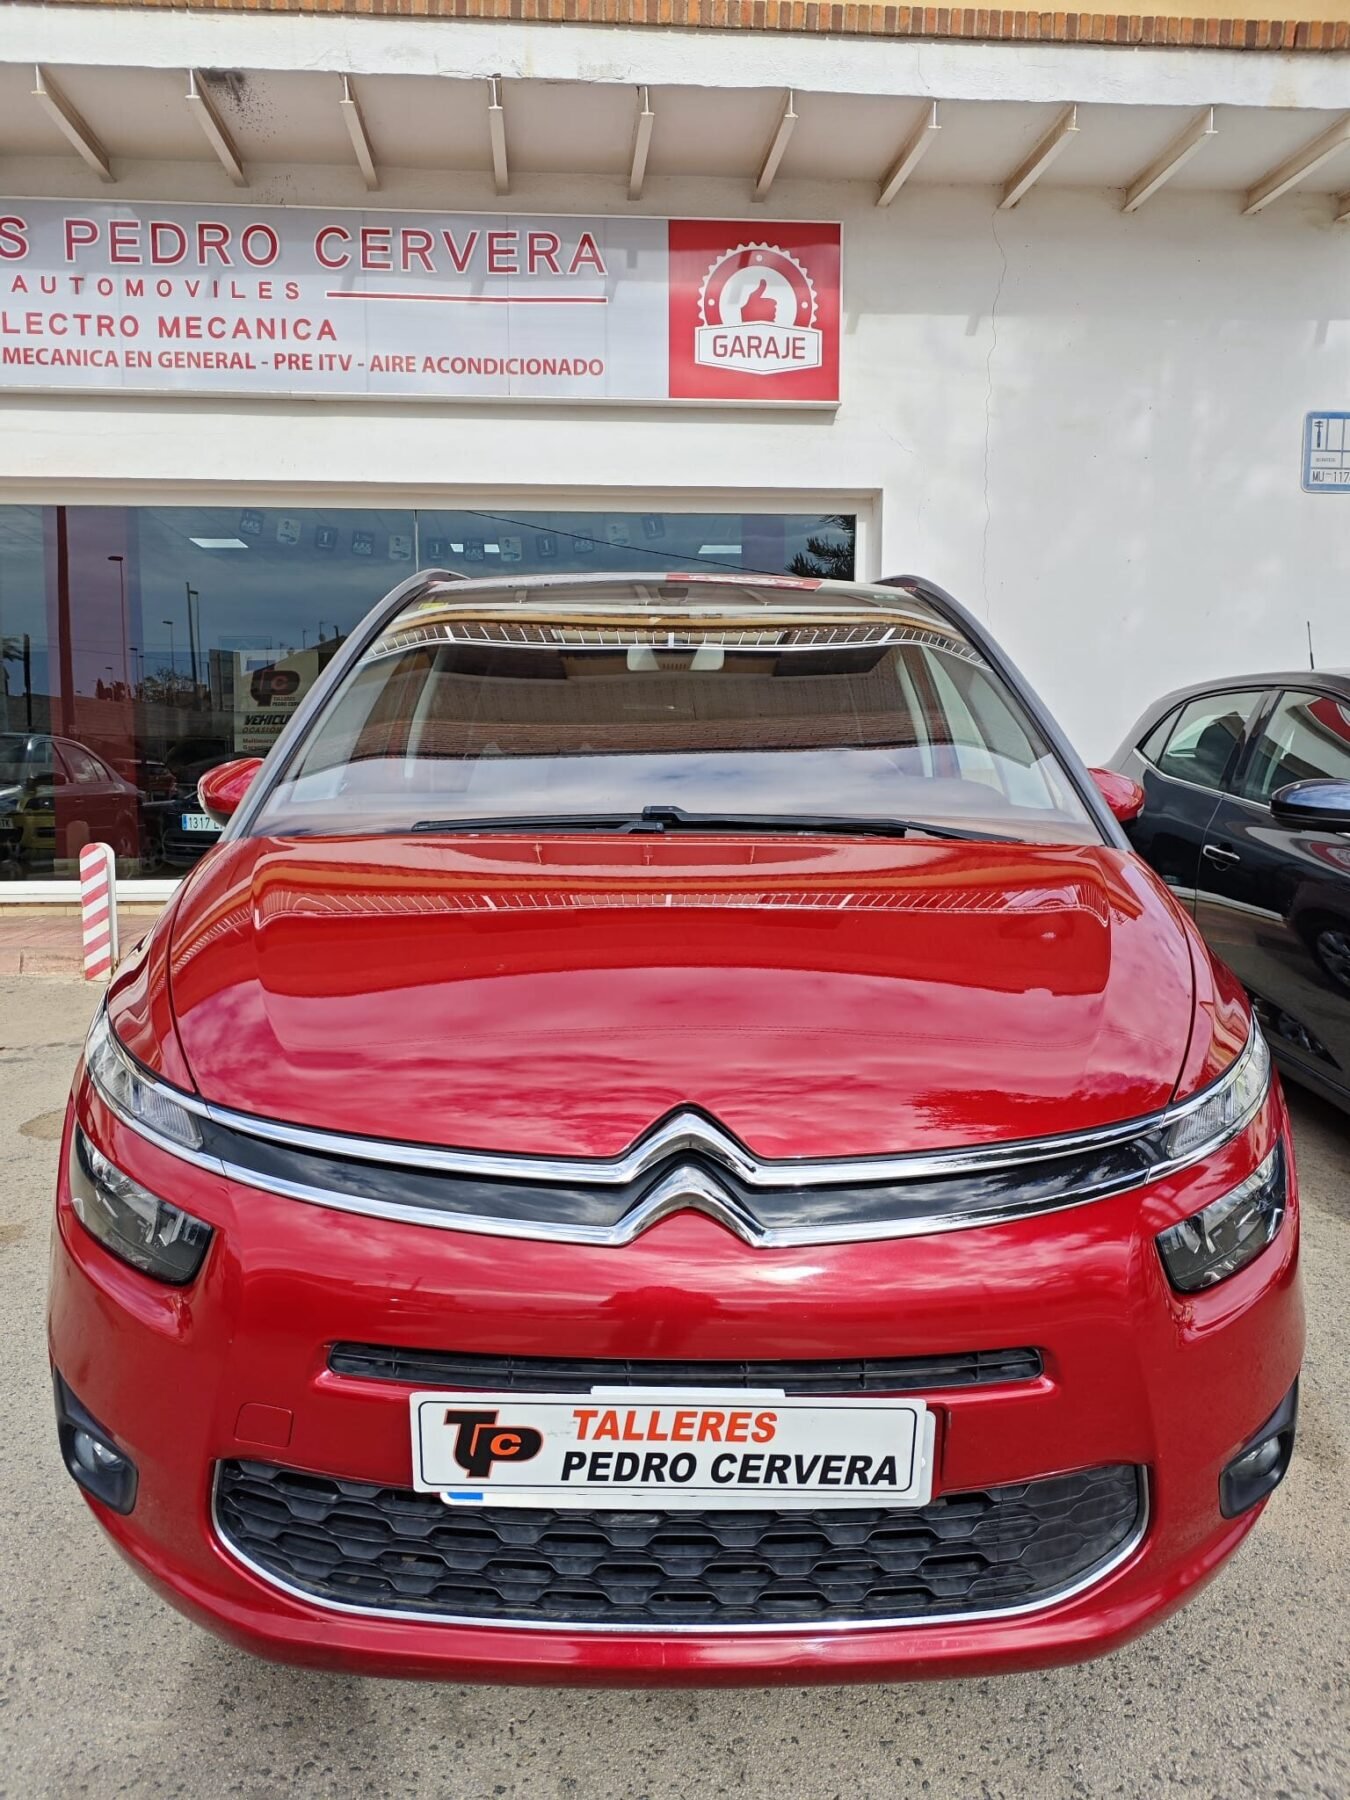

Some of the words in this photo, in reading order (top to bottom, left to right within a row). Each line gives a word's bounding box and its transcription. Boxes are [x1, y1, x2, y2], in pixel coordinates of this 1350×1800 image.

[0, 215, 29, 260] S
[64, 218, 280, 267] PEDRO
[314, 225, 607, 276] CERVERA
[11, 275, 300, 300] AUTOMOVILES
[158, 316, 338, 341] MECANICA
[712, 335, 806, 361] GARAJE
[3, 347, 119, 368] MECANICA
[125, 350, 152, 369] EN
[158, 351, 256, 371] GENERAL
[274, 353, 312, 371] PRE
[319, 355, 352, 372] ITV
[370, 355, 415, 373] AIRE
[422, 356, 604, 377] ACONDICIONADO
[1312, 470, 1350, 483] MU-117
[244, 715, 293, 725] VEHICU
[189, 817, 210, 829] 1317
[572, 1409, 778, 1443] TALLERES
[560, 1450, 698, 1482] PEDRO
[710, 1453, 898, 1486] CERVERA
